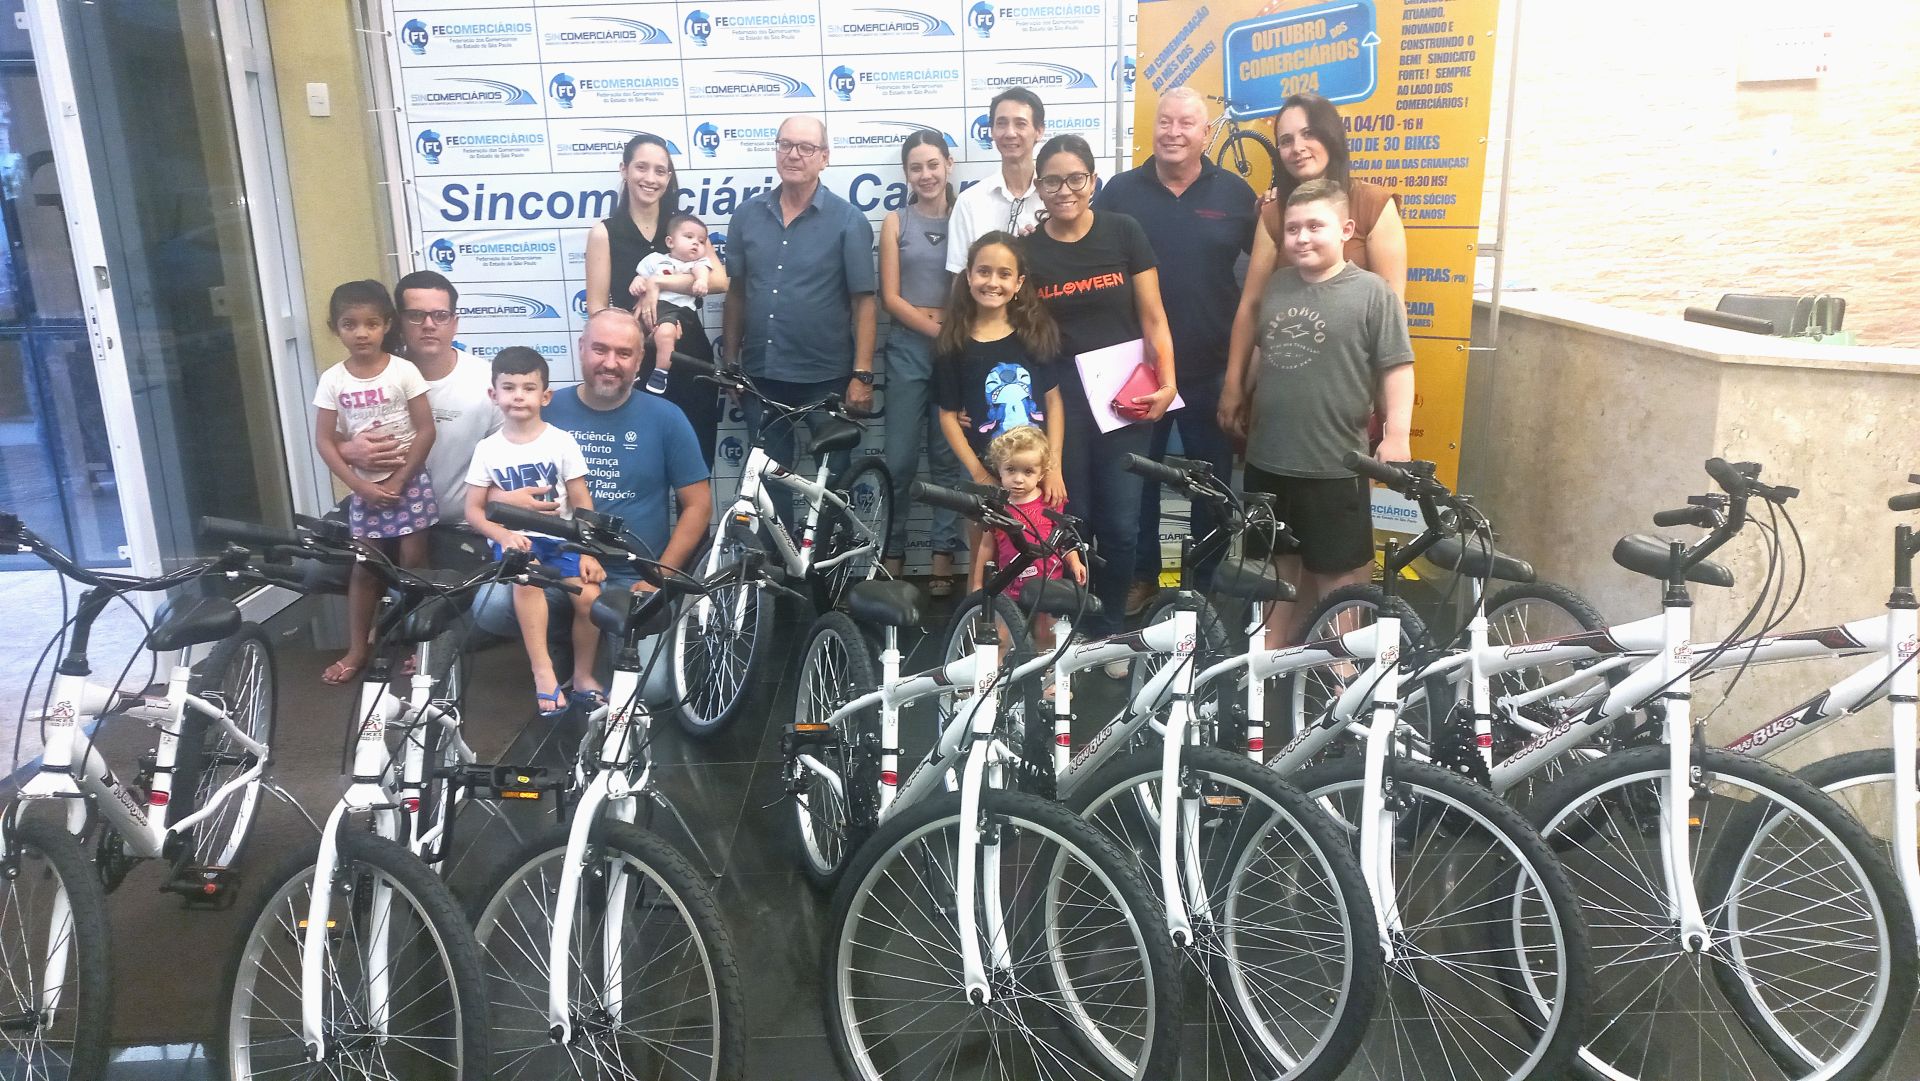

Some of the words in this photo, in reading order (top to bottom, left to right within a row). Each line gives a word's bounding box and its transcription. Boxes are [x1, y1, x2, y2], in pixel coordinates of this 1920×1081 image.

[1000, 4, 1100, 18] FECOMERCIÁRIOS
[715, 13, 816, 27] FECOMERCIÁRIOS
[432, 22, 532, 35] FECOMERCIÁRIOS
[827, 22, 920, 34] SINCOMERCIÁRIOS
[1402, 21, 1447, 35] INOVANDO
[1448, 21, 1454, 32] E
[544, 29, 637, 41] SINCOMERCIÁRIOS
[1252, 18, 1326, 52] OUTUBRO
[1329, 21, 1348, 39] DOS
[1401, 36, 1464, 50] CONSTRUINDO
[1467, 35, 1474, 46] O
[1239, 37, 1360, 81] COMERCIÁRIOS
[1428, 51, 1476, 63] SINDICATO
[859, 69, 959, 82] FECOMERCIÁRIOS
[1399, 69, 1424, 80] FORTE
[1436, 66, 1472, 78] SEMPRE
[579, 77, 679, 90] FECOMERCIÁRIOS
[971, 75, 1063, 86] SINCOMERCIÁRIOS
[1280, 71, 1320, 98] 2024
[689, 84, 780, 95] SINCOMERCIÁRIOS
[1397, 84, 1409, 95] AO
[1411, 83, 1433, 95] LADO
[1434, 82, 1453, 93] DOS
[411, 91, 502, 103] SINCOMERCIÁRIOS
[1396, 96, 1464, 110] COMERCIÁRIOS
[1044, 117, 1100, 129] ERCIÁRIOS
[1354, 114, 1395, 132] 04/10
[1403, 118, 1414, 130] 16
[1416, 118, 1423, 130] H
[446, 133, 544, 145] FECOMERCIÁRIOS
[724, 128, 778, 139] FECOMER
[1364, 137, 1379, 152] DE
[1384, 136, 1400, 151] 30
[1404, 135, 1440, 151] BIKES
[1371, 160, 1382, 170] AO
[1386, 159, 1400, 169] DIA
[1402, 159, 1419, 169] DAS
[1420, 157, 1469, 170] CRIANÇAS!
[1405, 176, 1429, 187] 18:30
[1431, 176, 1448, 187] HS!
[1404, 195, 1421, 205] DOS
[1423, 193, 1456, 205] SÓCIOS
[1408, 209, 1417, 219] 12
[1420, 209, 1446, 219] ANOS!
[459, 242, 556, 254] FECOMERCIÁRIOS
[1407, 268, 1451, 282] MPRAS
[1037, 272, 1125, 299] ALLOWEEN
[456, 305, 527, 315] COMERCIÁRIOS
[338, 387, 391, 409] GIRL
[568, 430, 616, 443] Eficiência
[578, 443, 612, 454] nforto
[584, 457, 619, 468] urança
[595, 479, 617, 489] Para
[595, 490, 636, 501] Negócio
